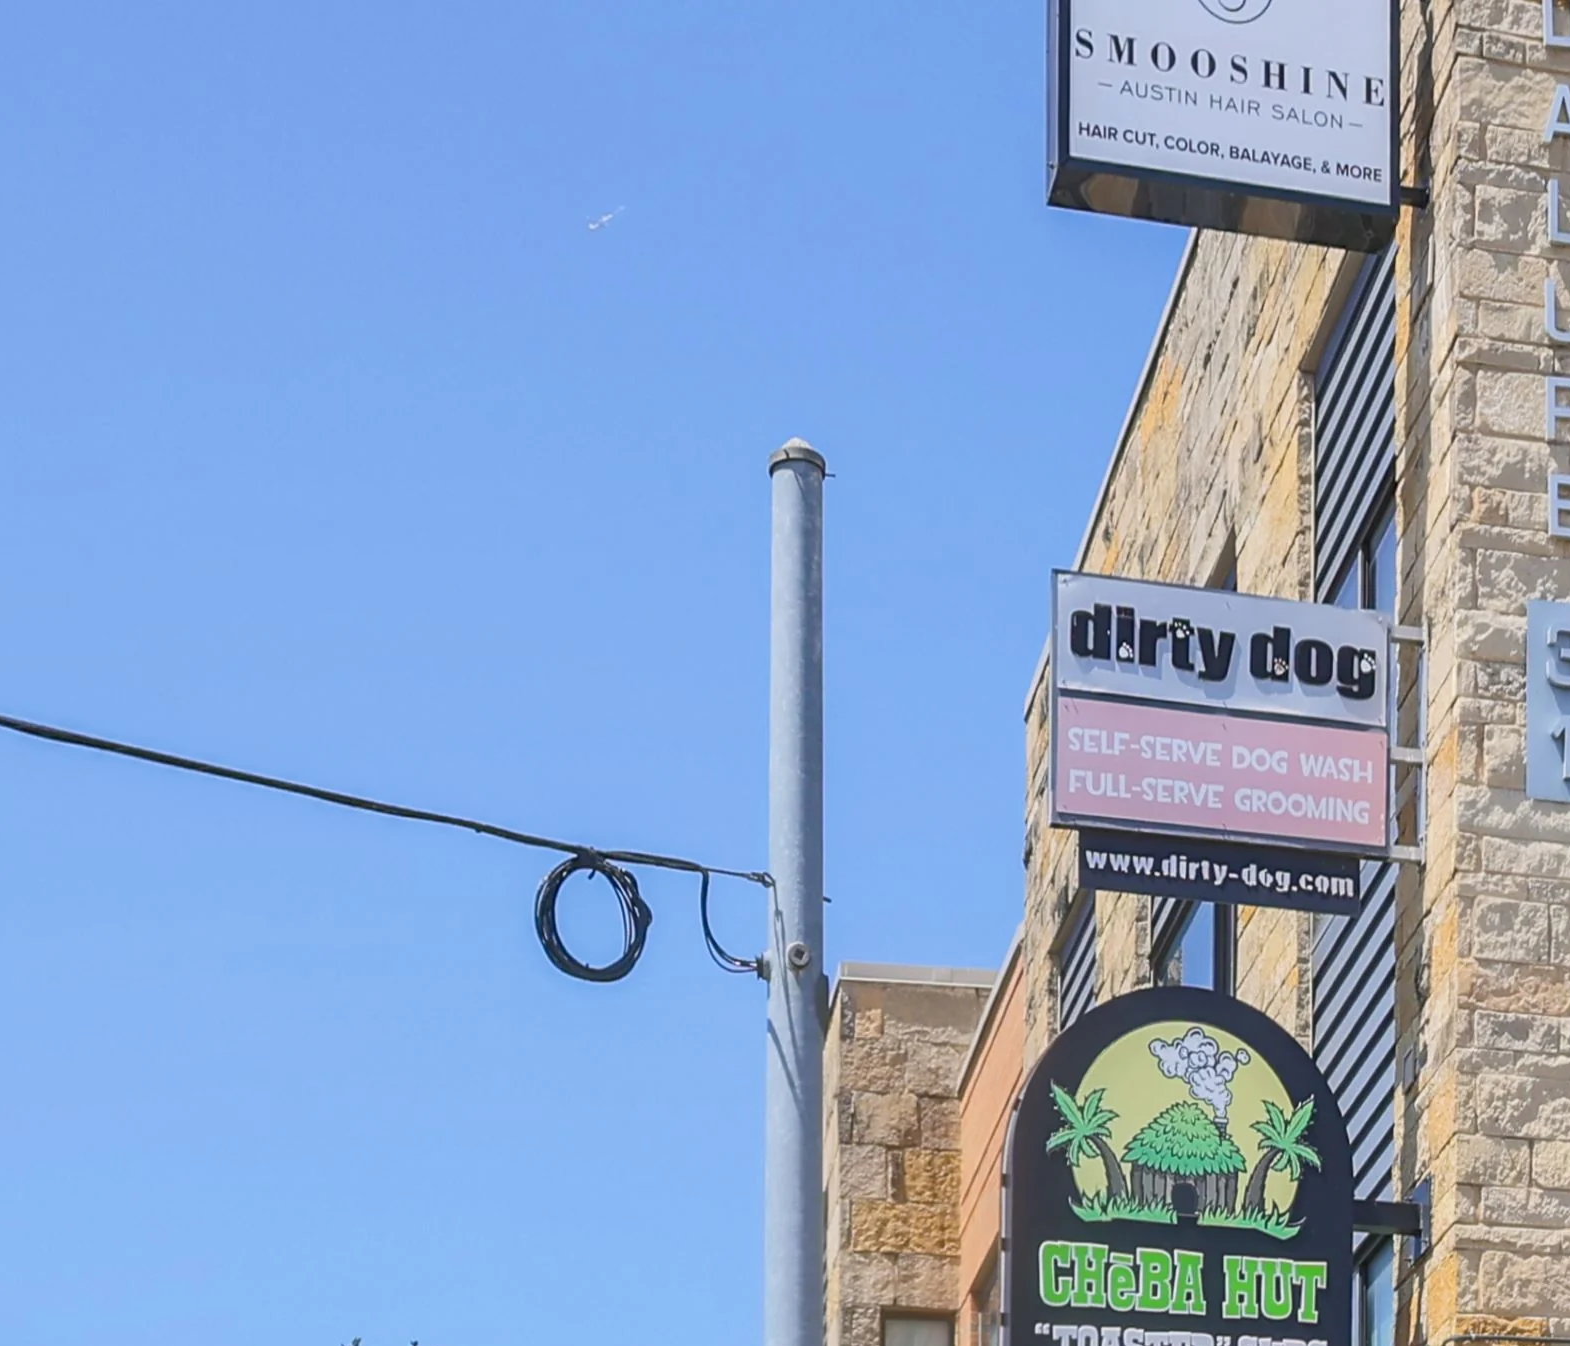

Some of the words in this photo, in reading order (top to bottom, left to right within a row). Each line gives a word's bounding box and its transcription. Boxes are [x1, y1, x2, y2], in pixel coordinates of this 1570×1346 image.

[1074, 28, 1386, 107] SMOOSHINE
[1119, 79, 1198, 106] AUSTIN
[1209, 95, 1261, 117] HAIR
[1271, 104, 1344, 130] SALON
[1078, 121, 1118, 142] HAIR
[1122, 129, 1160, 149] CUT,
[1163, 134, 1225, 159] COLOR,
[1228, 145, 1317, 174] BALAYAGE,
[1320, 160, 1331, 175] &
[1335, 162, 1383, 183] MORE
[1070, 602, 1236, 682] dirty
[1249, 626, 1377, 700] dog
[1067, 727, 1223, 768] SELF-SERVE
[1231, 745, 1289, 774] DOG
[1300, 754, 1373, 784] WASH
[1068, 768, 1224, 810] FULL-SERVE
[1234, 789, 1370, 825] GROOMING
[1085, 848, 1356, 899] www.dirty-dog.com
[1222, 1255, 1328, 1323] HUT
